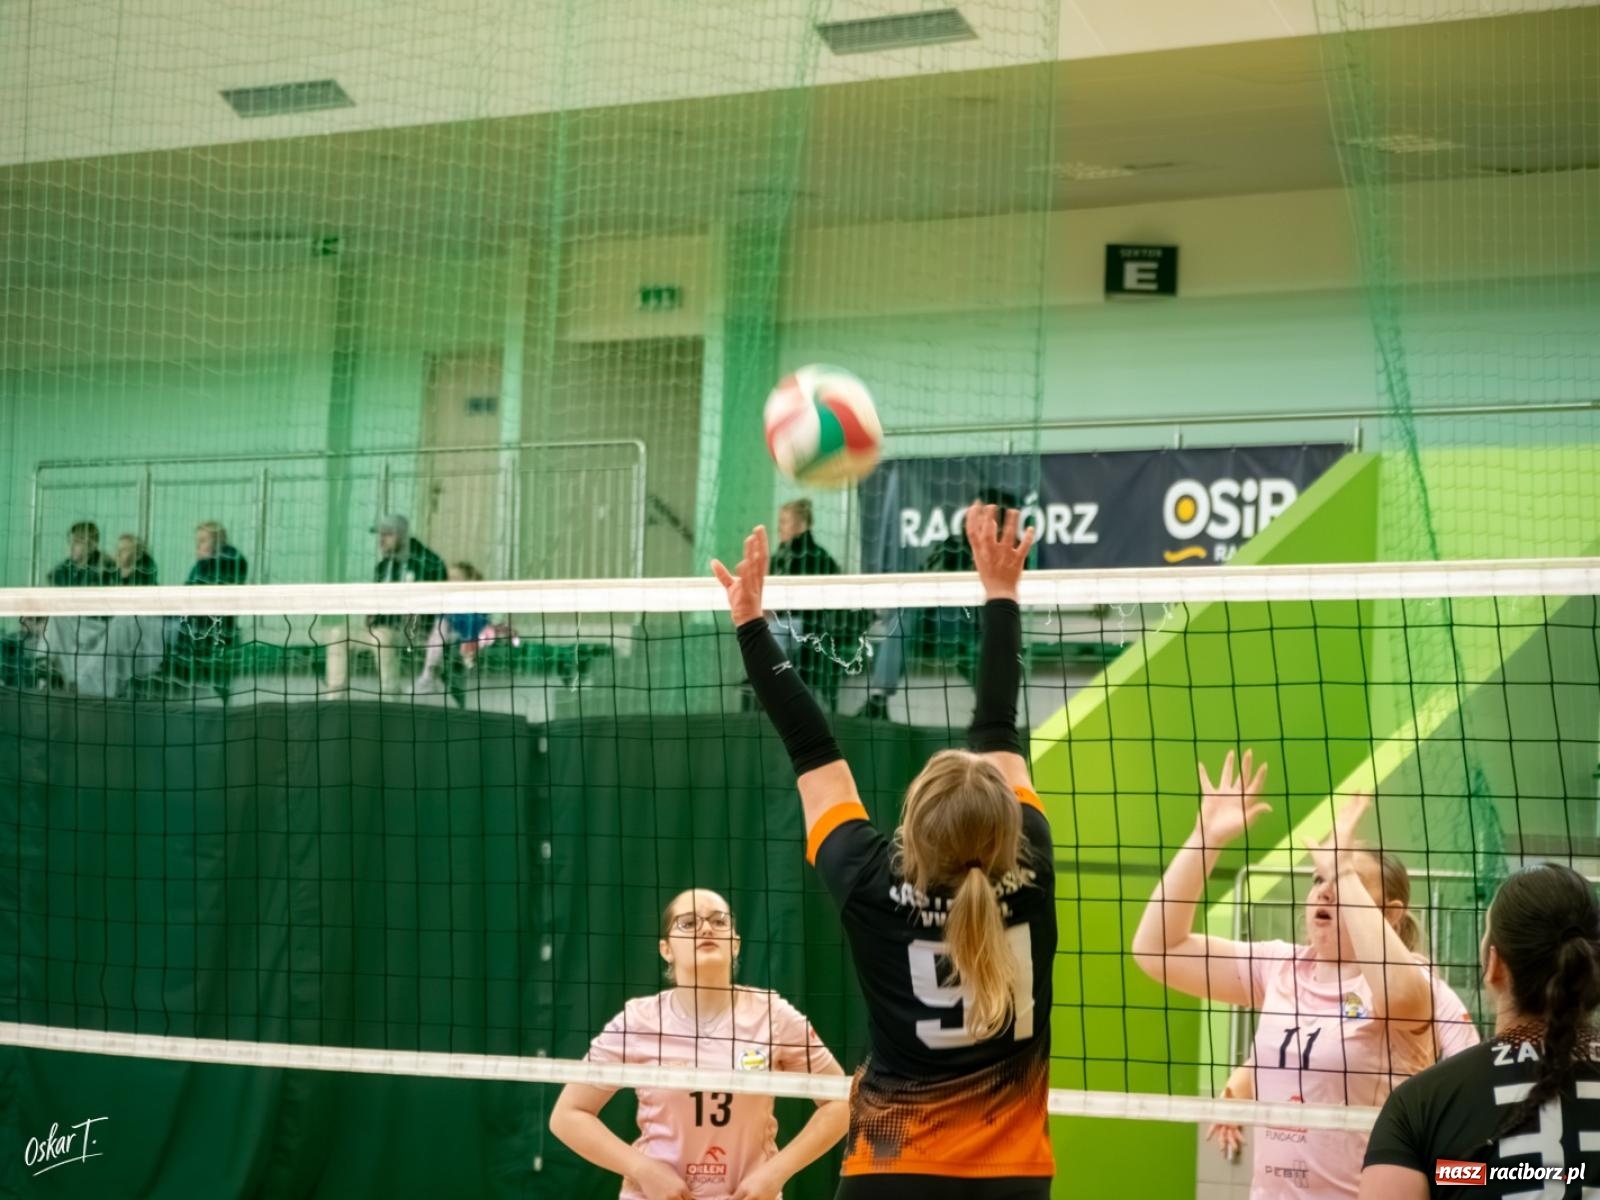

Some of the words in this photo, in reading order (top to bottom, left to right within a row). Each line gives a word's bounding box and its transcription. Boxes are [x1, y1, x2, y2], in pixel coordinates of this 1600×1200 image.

[1123, 261, 1159, 290] E
[900, 491, 1099, 549] RAÓRZ
[908, 920, 1034, 1050] 91
[1278, 1026, 1322, 1071] 11
[689, 1091, 734, 1128] 13
